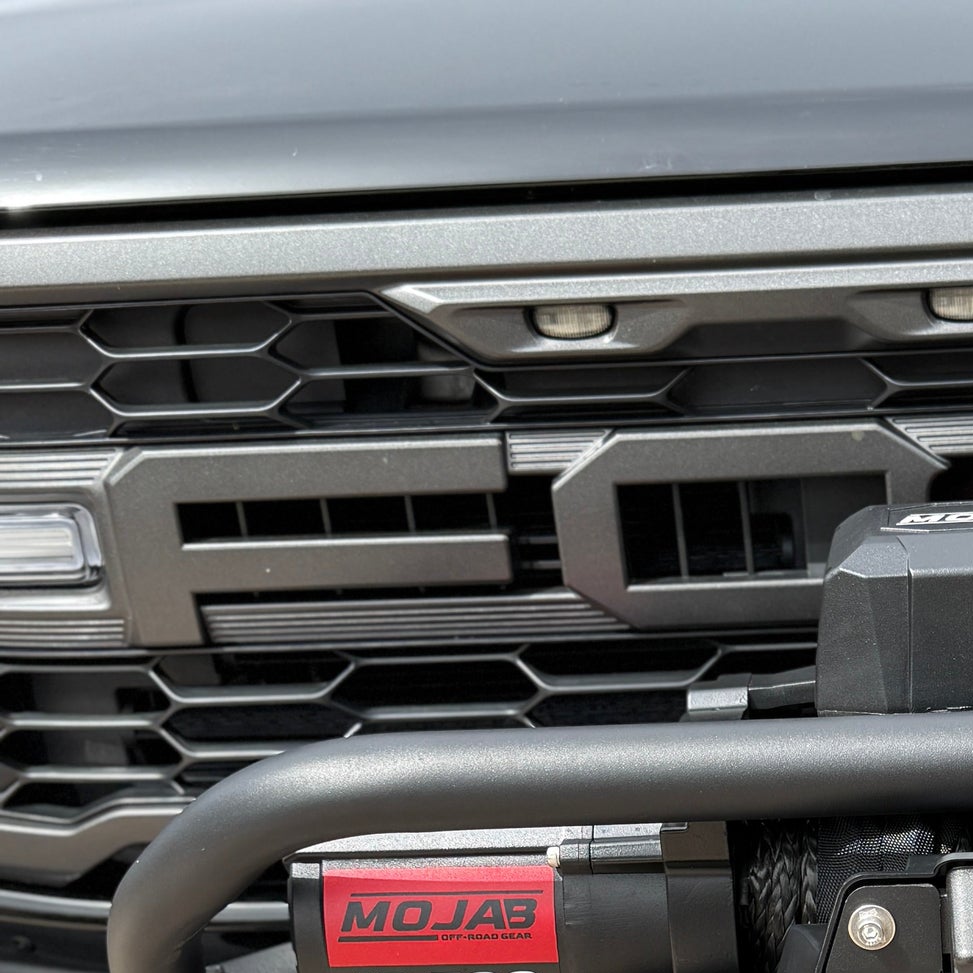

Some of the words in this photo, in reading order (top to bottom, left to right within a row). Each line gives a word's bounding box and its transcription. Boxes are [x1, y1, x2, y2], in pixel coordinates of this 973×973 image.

[341, 898, 538, 932] MOJAB
[441, 933, 499, 941] OFF-ROAD
[501, 932, 532, 940] GEAR
